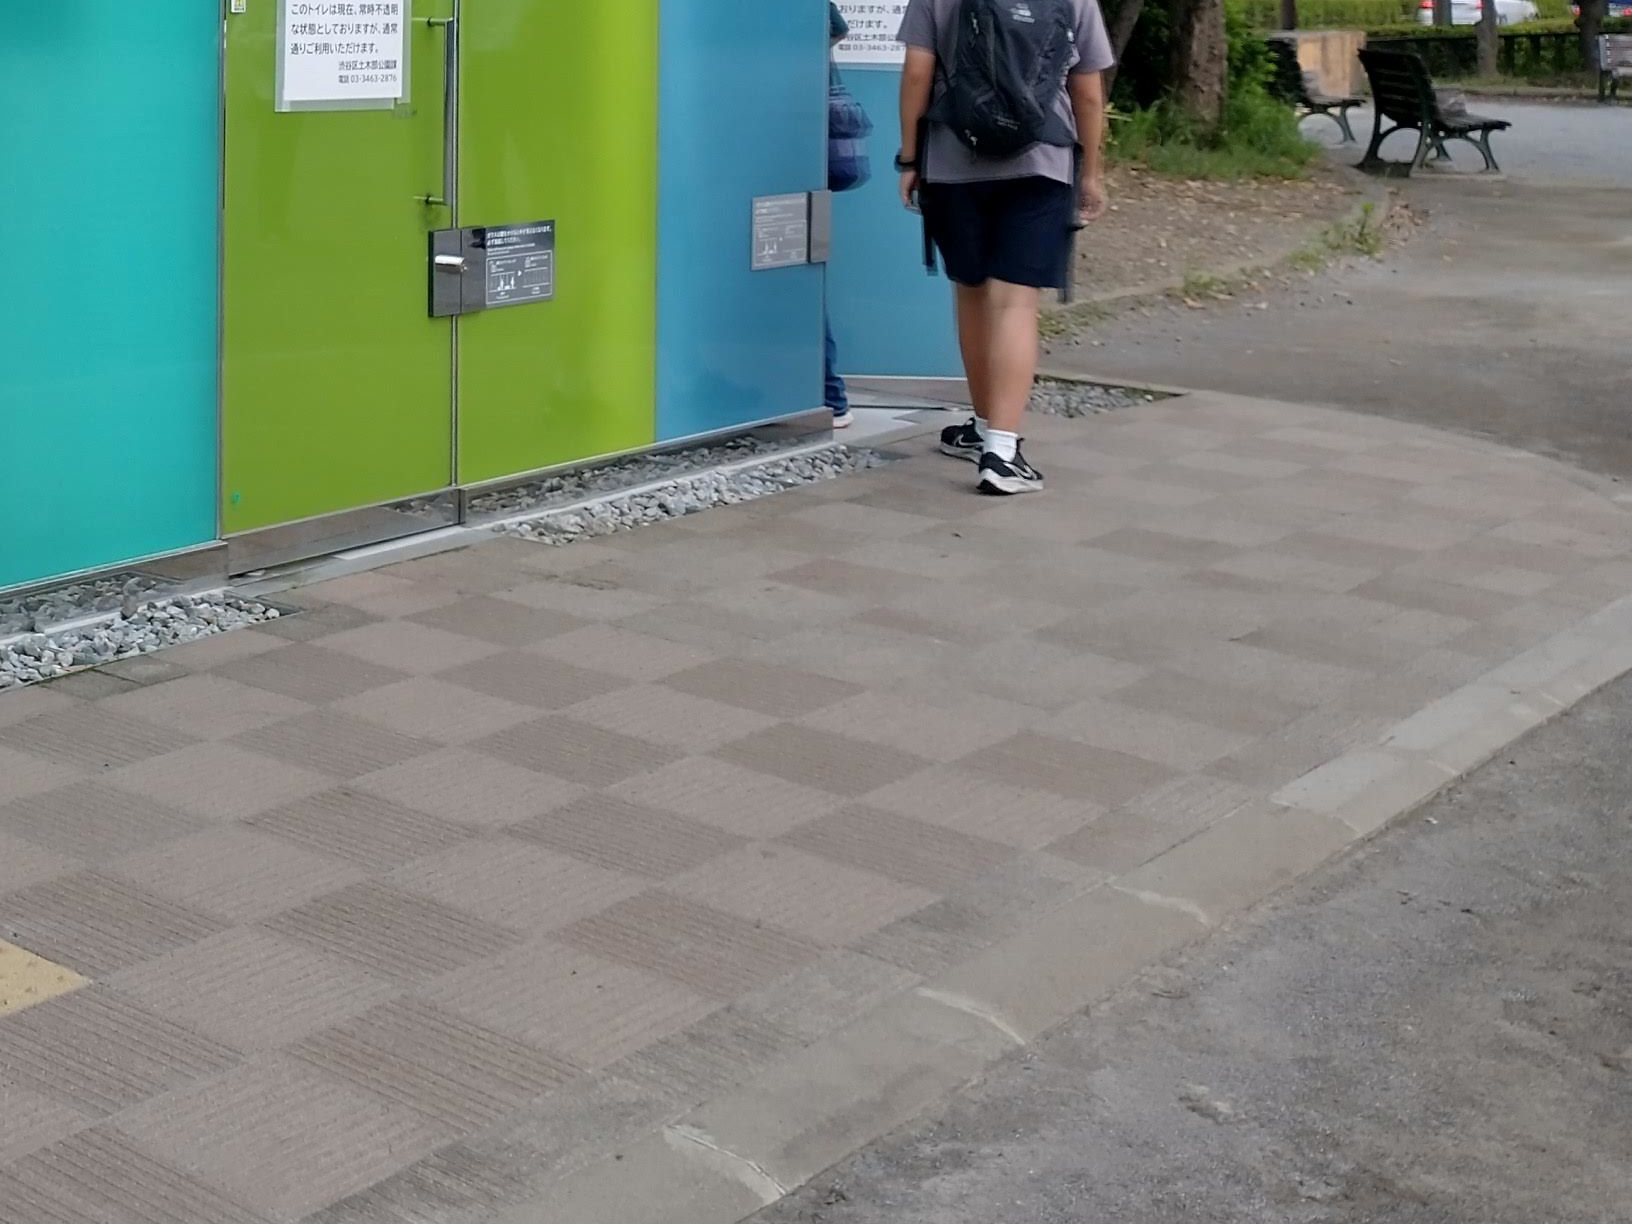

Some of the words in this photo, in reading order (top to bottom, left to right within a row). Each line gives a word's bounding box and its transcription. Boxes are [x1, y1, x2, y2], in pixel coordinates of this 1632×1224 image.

[292, 3, 398, 15] このトイレは現在、常時不透明
[292, 24, 398, 35] な状態としておりますが、通常
[291, 43, 378, 55] 通りご利用いただけます。
[351, 73, 397, 83] 03-3463-2876
